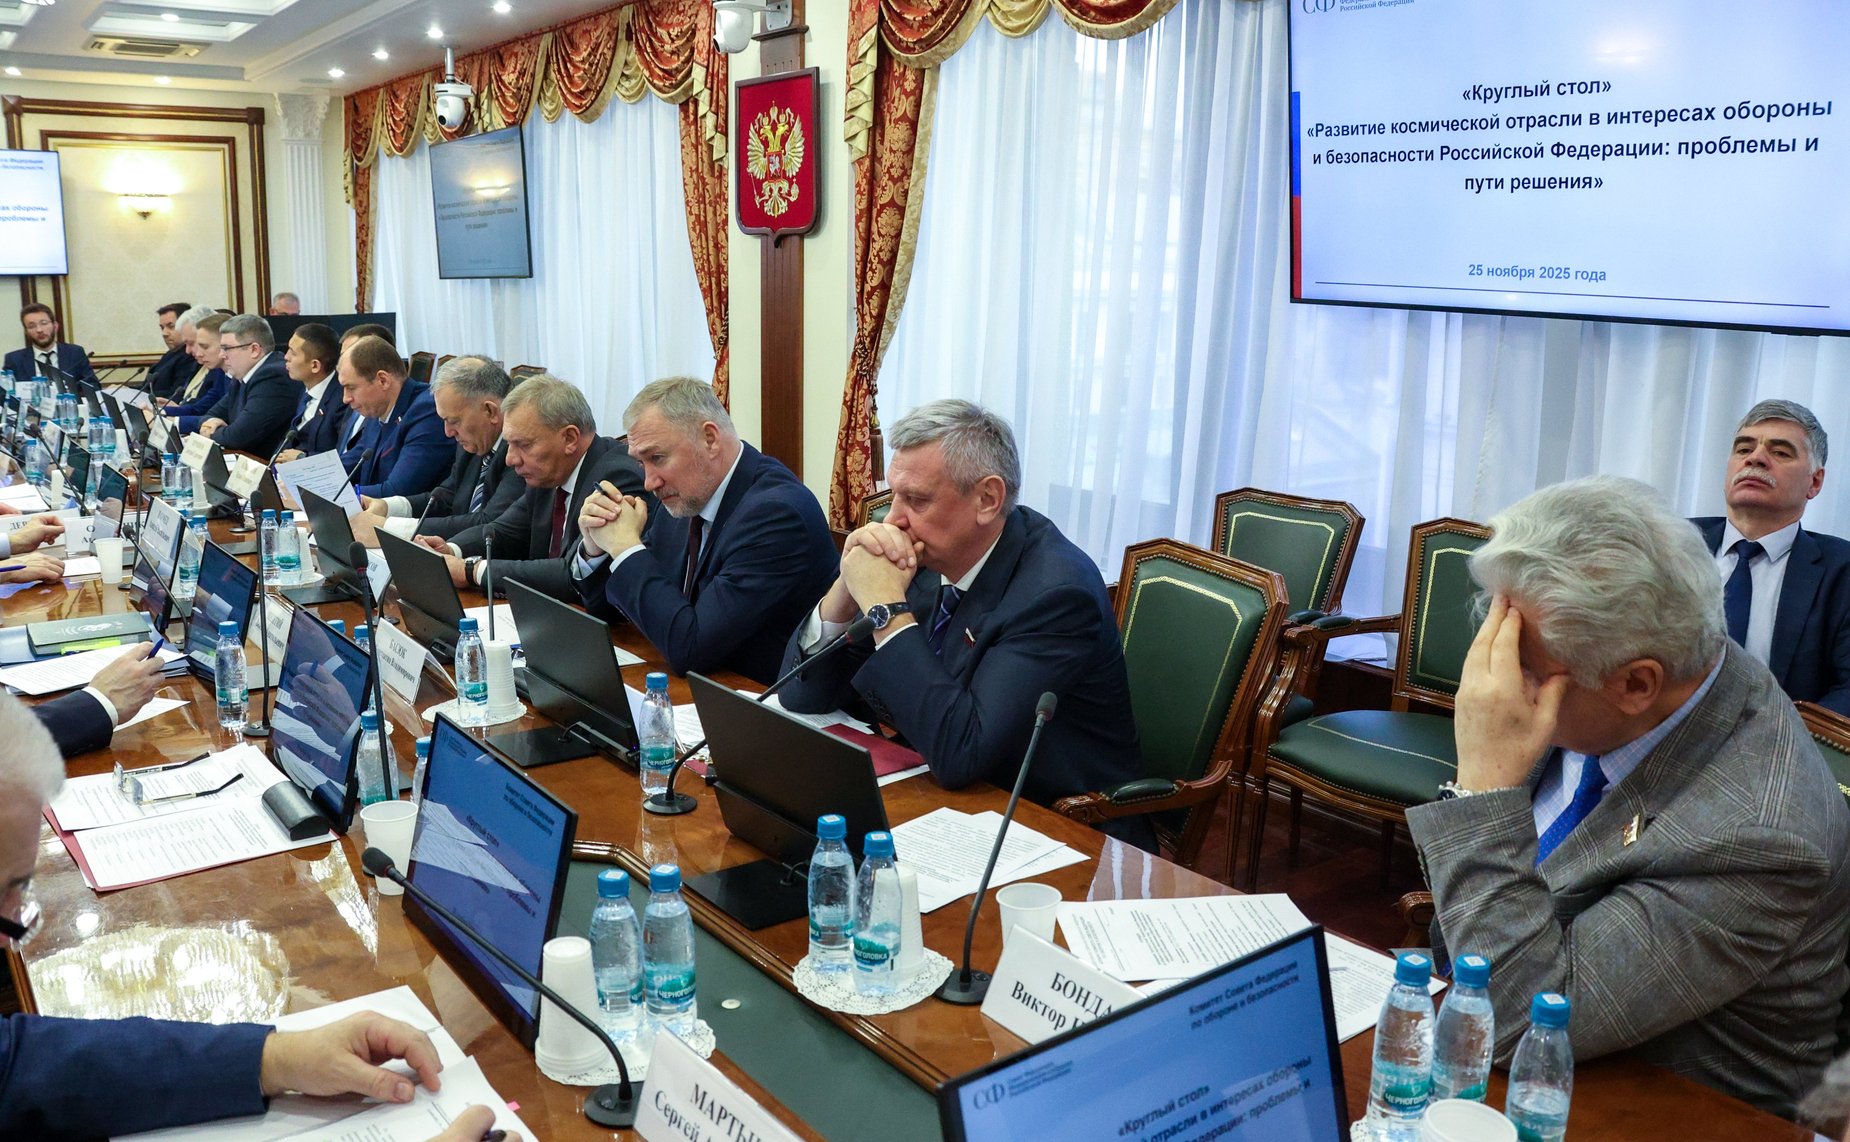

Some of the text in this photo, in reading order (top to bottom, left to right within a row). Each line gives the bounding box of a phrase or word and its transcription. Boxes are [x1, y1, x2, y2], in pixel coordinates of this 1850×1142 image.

[1462, 80, 1612, 103] «Круглый стол»
[1307, 100, 1832, 139] «Развитие космической отрасли в интересах обороны
[1313, 136, 1819, 164] и безопасности Российской Федерации: проблемы и
[1464, 176, 1603, 194] пути решения»
[1469, 264, 1606, 282] 25 ноября 2025 года
[1011, 980, 1066, 1031] Виктор
[655, 1090, 700, 1142] Сергей
